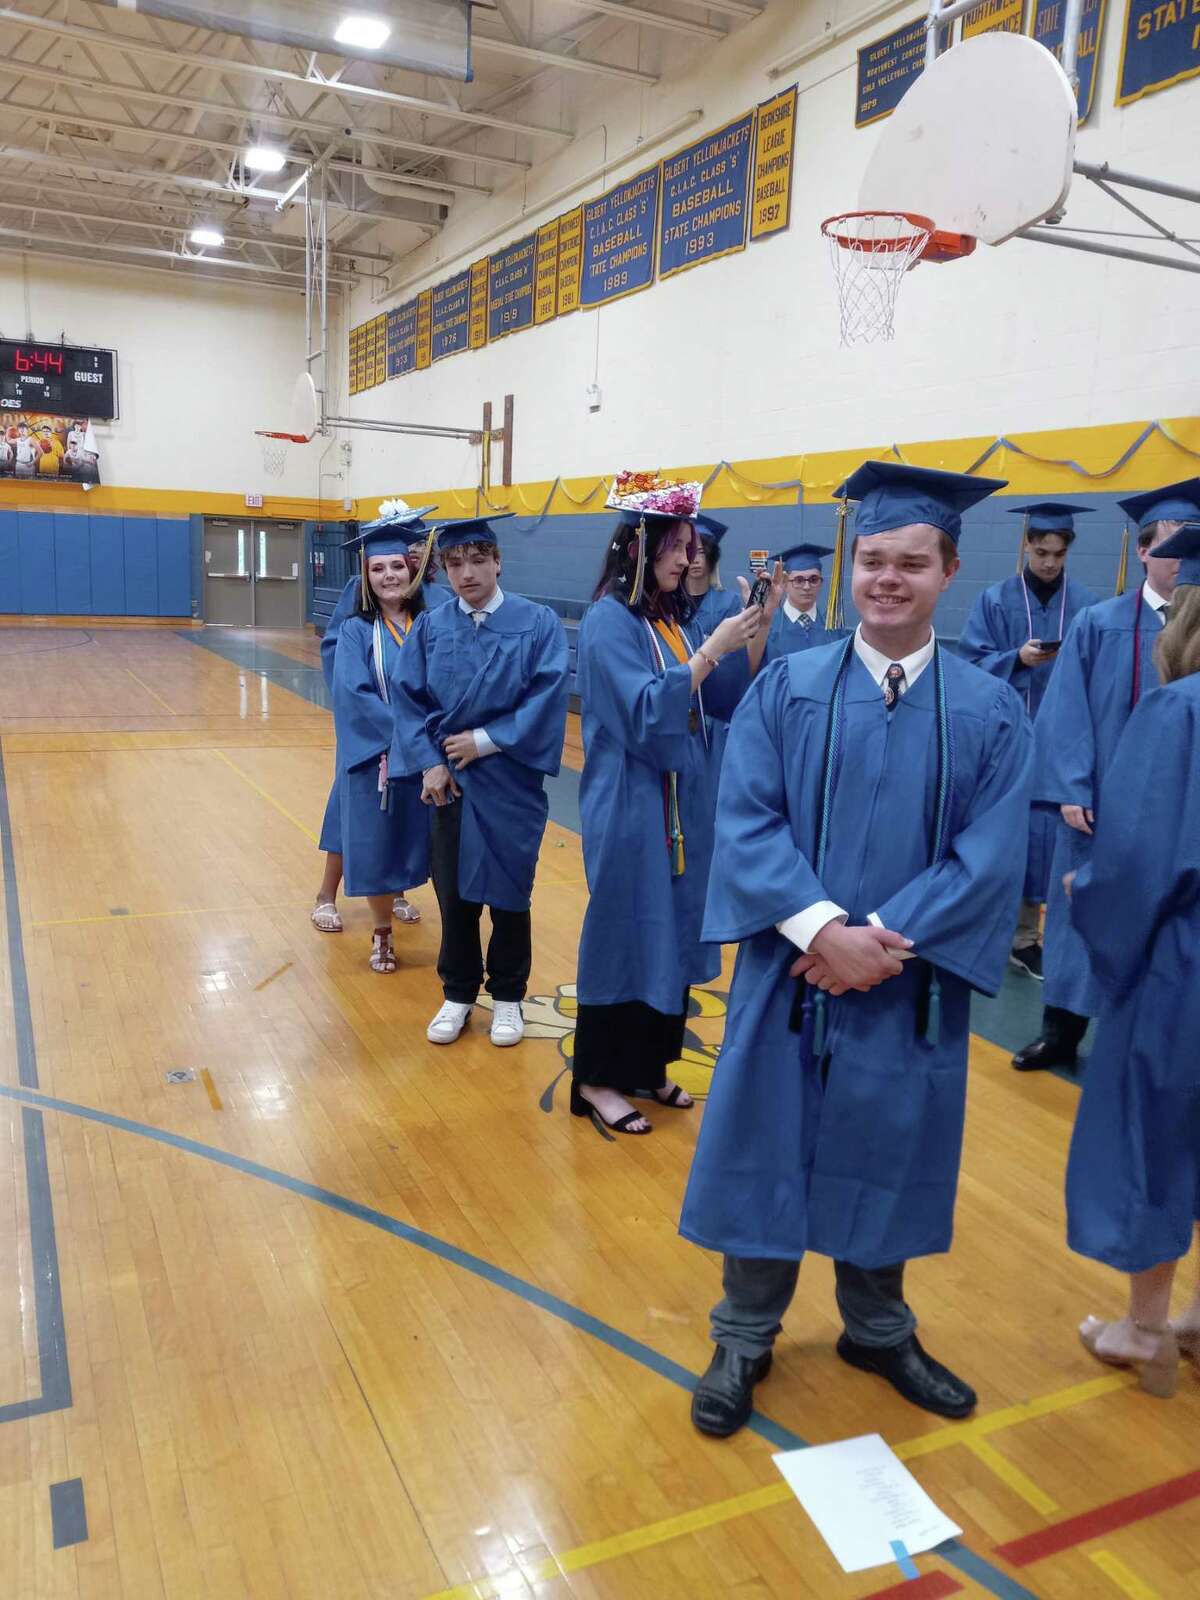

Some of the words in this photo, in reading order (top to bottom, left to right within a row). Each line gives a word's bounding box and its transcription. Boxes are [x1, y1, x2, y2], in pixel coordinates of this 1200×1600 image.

[760, 101, 792, 130] BERKSHIRE
[664, 155, 690, 181] GILBERT
[693, 125, 750, 167] YELLOWJACKETS
[763, 128, 786, 153] LEAGUE
[701, 161, 726, 183] CLASS
[758, 151, 789, 179] CHAMPIONS
[586, 202, 607, 221] GILBERT
[610, 175, 656, 210] YELLOWJACKETS
[672, 179, 734, 218] BASEBALL
[756, 178, 785, 204] BASEBALL
[616, 205, 637, 226] CLASS
[664, 221, 689, 244] STATE
[692, 200, 742, 232] CHAMPIONS
[759, 204, 780, 225] 1997
[593, 224, 642, 257] BASEBALL
[685, 232, 714, 256] 1993
[609, 242, 648, 270] CHAMPIONS
[603, 271, 628, 292] 1989
[16, 348, 62, 375] 6:44
[21, 376, 44, 384] PERIOD
[74, 371, 103, 383] GUEST
